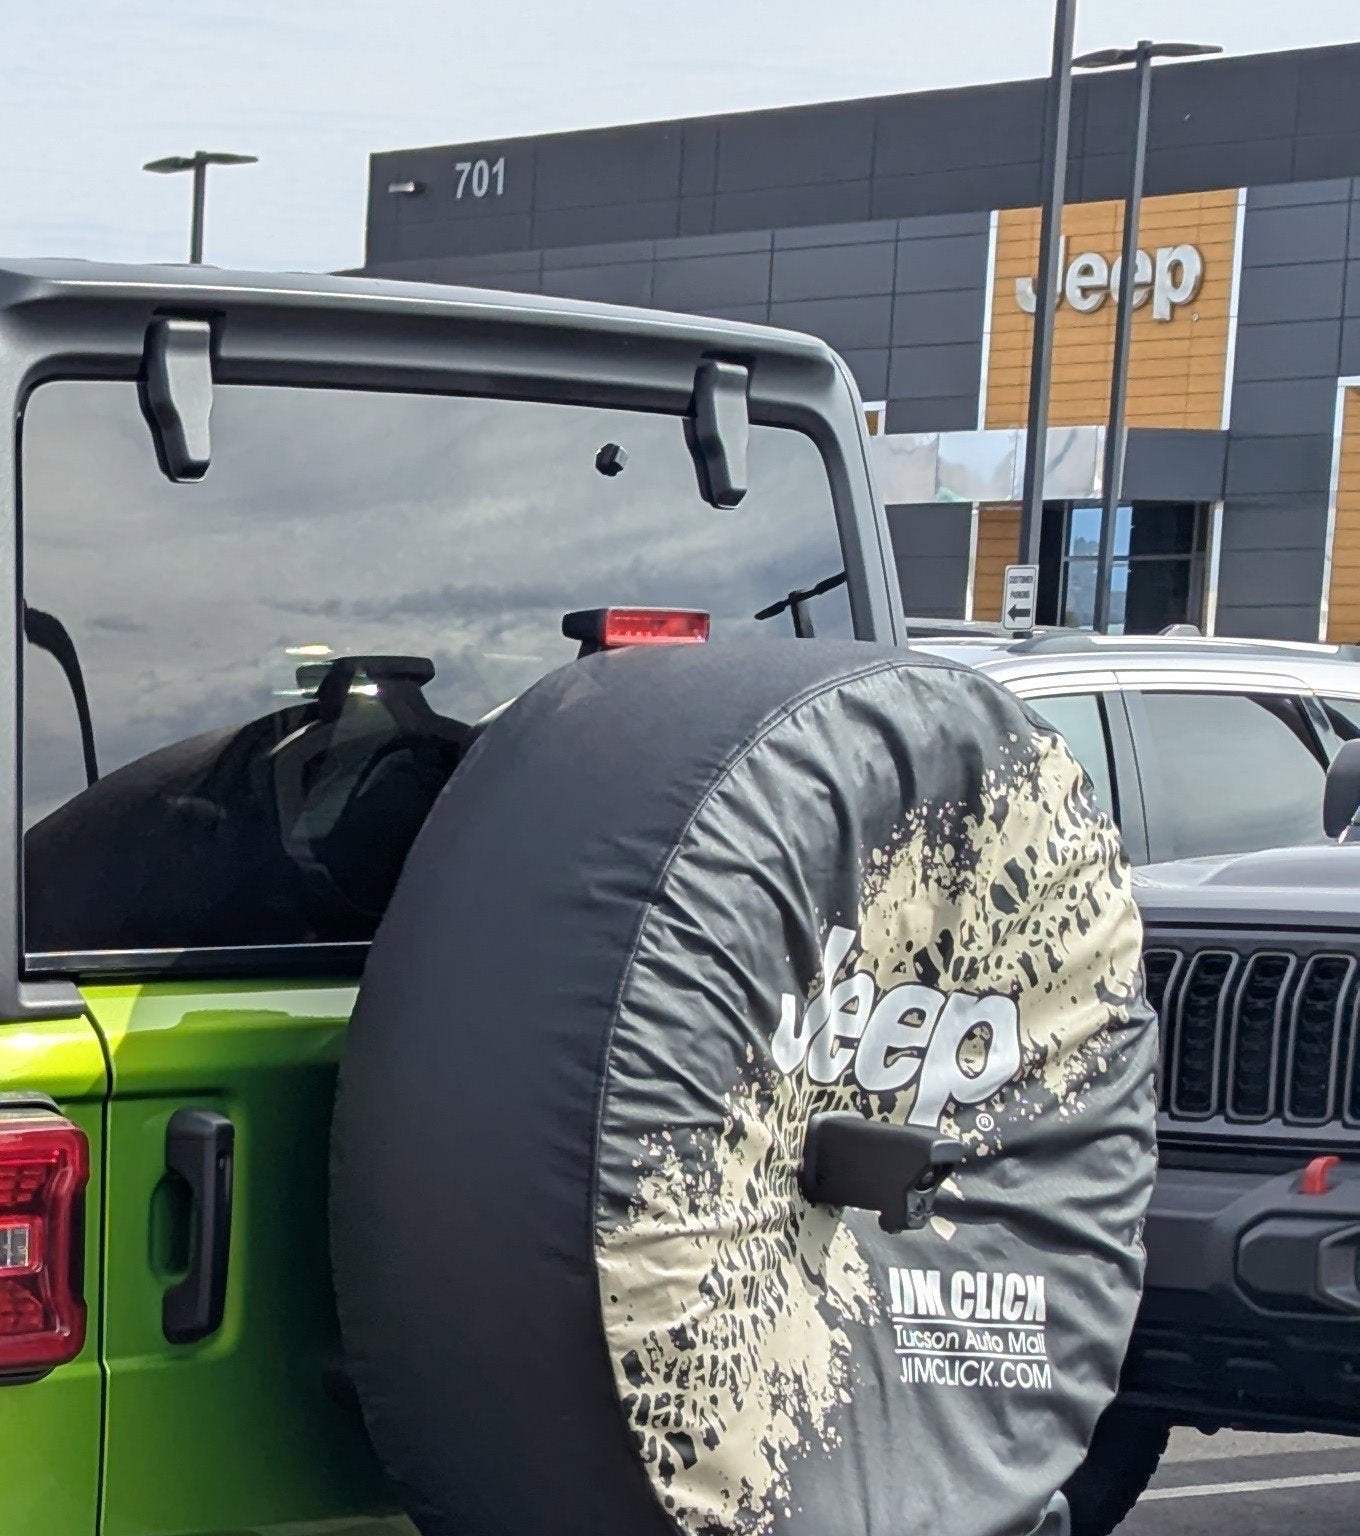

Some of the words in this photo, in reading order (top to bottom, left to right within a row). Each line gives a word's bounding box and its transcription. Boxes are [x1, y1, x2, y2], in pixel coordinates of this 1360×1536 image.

[454, 157, 505, 199] 701
[1015, 234, 1203, 322] Jeep
[771, 925, 1022, 1128] Jeep
[888, 1266, 946, 1316] JIM
[950, 1270, 1047, 1322] CLICK
[893, 1324, 960, 1350] Tucson
[964, 1329, 1004, 1353] Auto
[1008, 1331, 1047, 1355] Mall
[899, 1356, 1052, 1389] JIMCLICK.COM
